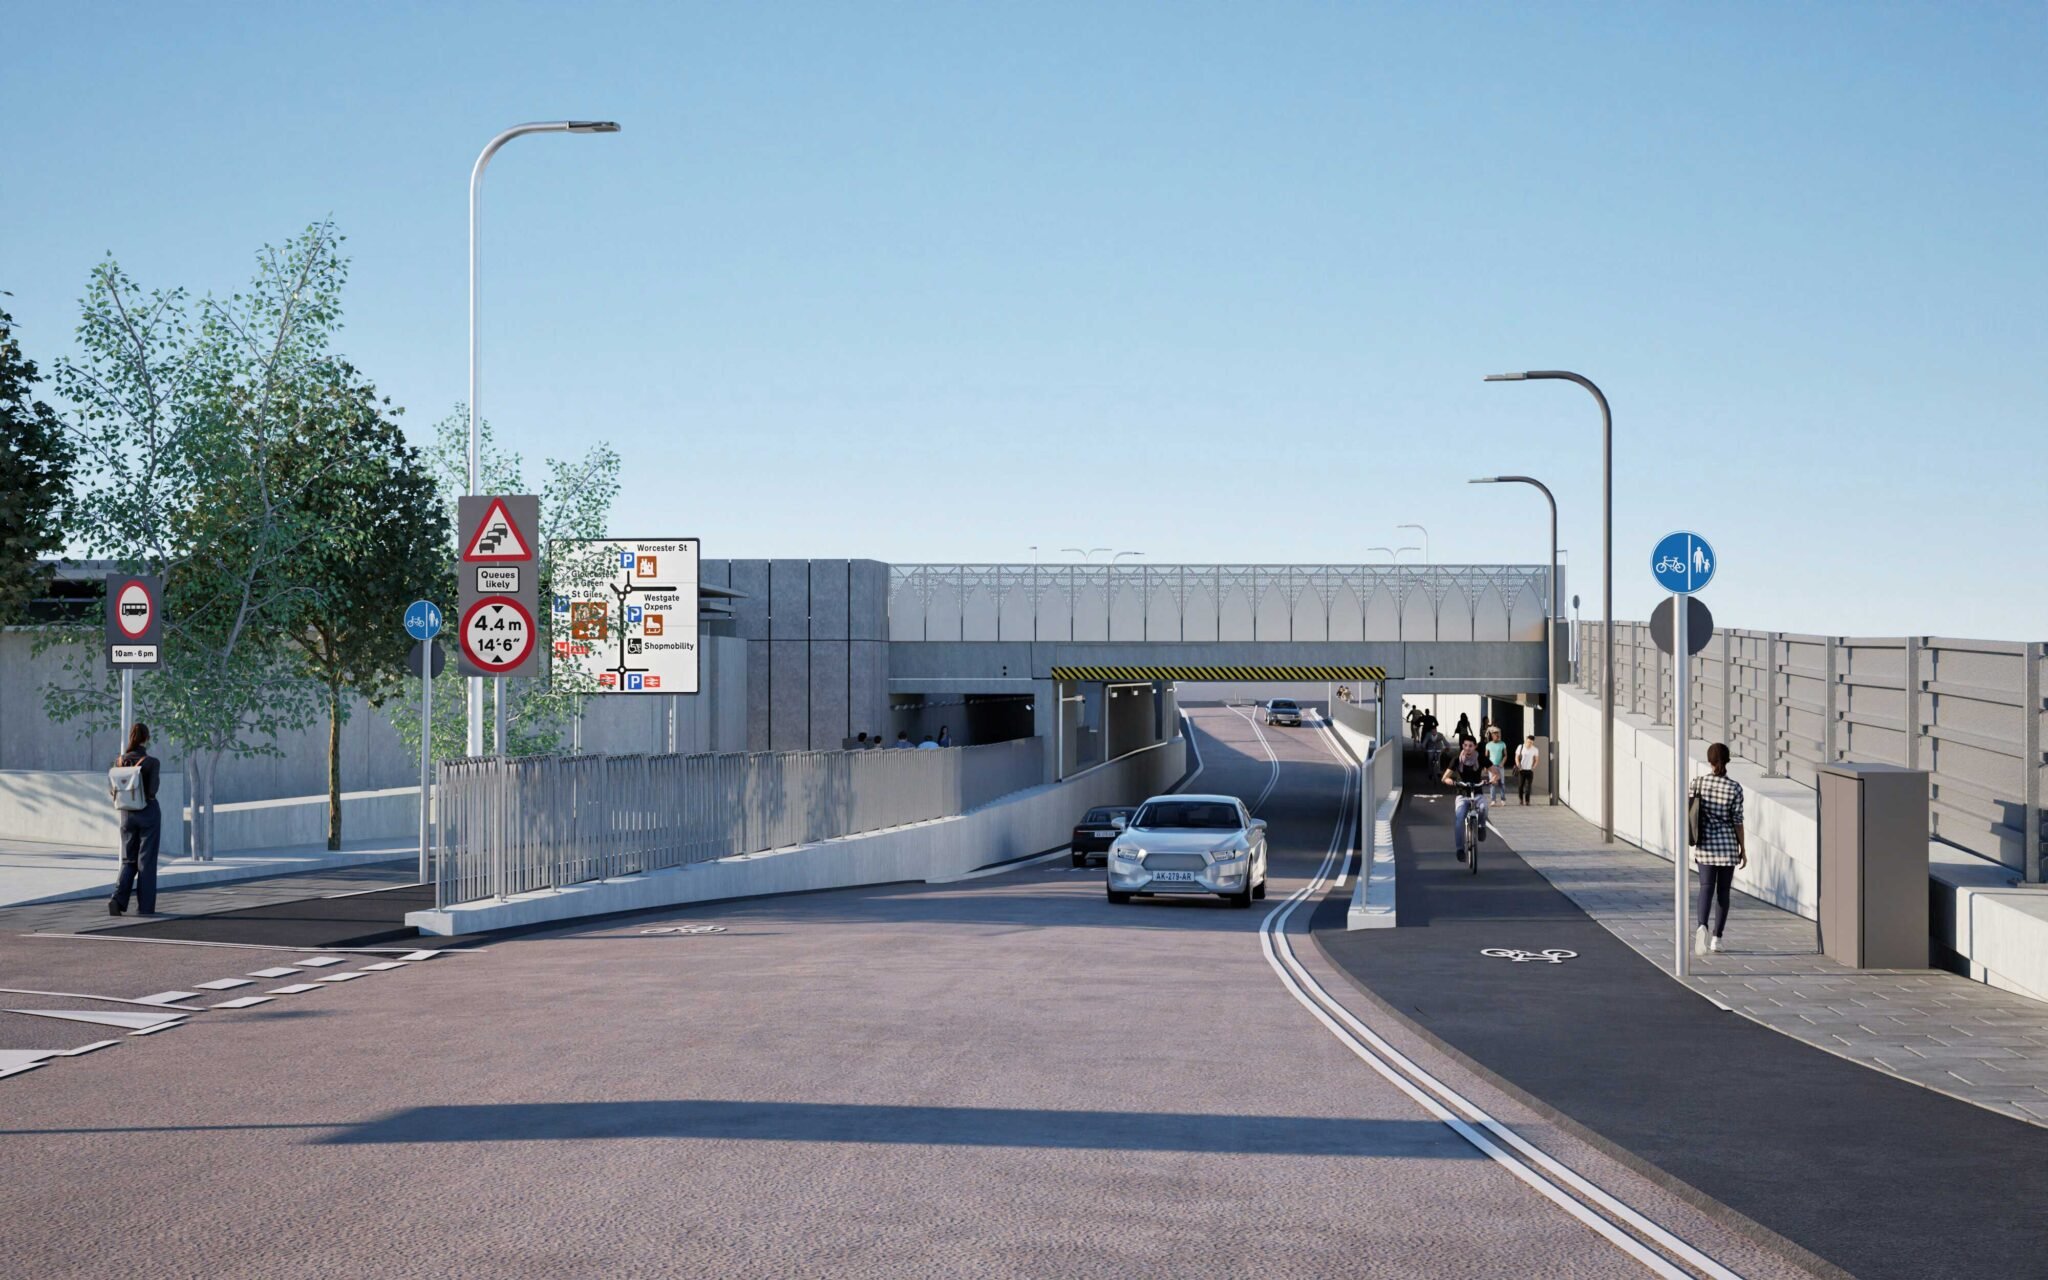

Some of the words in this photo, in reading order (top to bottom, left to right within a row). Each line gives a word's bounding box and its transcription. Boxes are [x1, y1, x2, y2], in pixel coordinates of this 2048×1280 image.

[637, 544, 675, 552] Worcester
[678, 544, 688, 552] St
[481, 570, 515, 579] Queues
[486, 580, 510, 589] likely
[571, 590, 581, 598] St
[583, 590, 603, 598] Giles
[644, 594, 680, 602] Westgate
[644, 603, 673, 611] Oxpens
[474, 615, 505, 631] 4.4
[508, 621, 522, 631] m
[644, 642, 694, 651] Shopmobility
